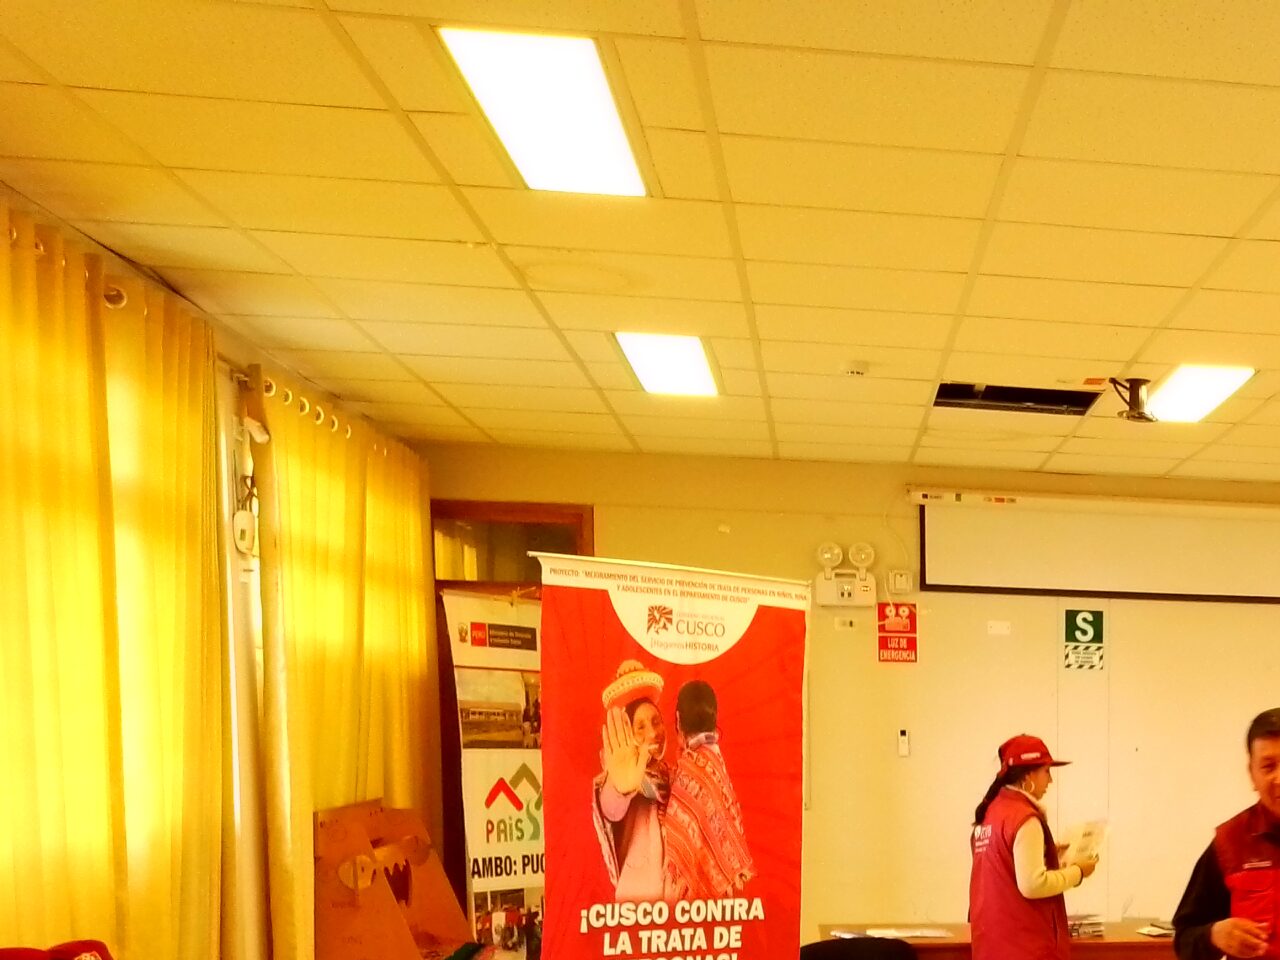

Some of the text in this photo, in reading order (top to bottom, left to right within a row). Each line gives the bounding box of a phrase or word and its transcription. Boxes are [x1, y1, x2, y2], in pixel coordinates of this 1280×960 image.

[676, 619, 726, 638] CUSCO
[1075, 611, 1094, 642] S
[470, 855, 517, 879] AMBO:
[580, 897, 765, 934] ¡CUSCO CONTRA
[603, 925, 742, 956] LA TRATA DE
